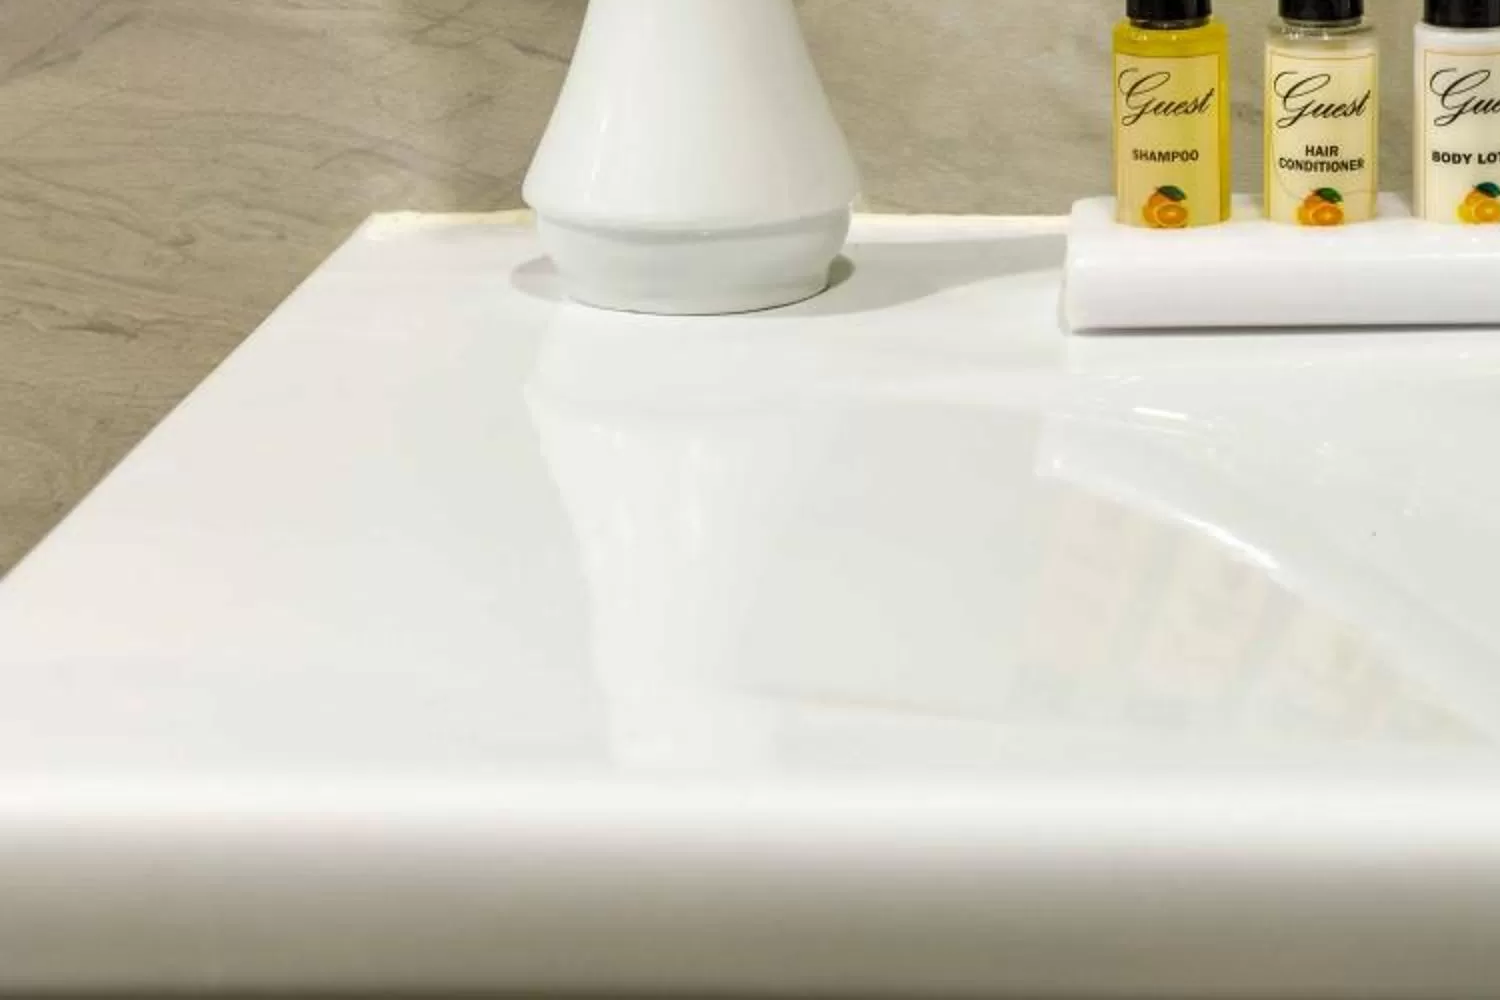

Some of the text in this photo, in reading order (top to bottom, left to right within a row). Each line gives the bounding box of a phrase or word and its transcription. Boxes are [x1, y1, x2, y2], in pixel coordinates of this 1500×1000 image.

[1117, 67, 1215, 127] Guest
[1273, 71, 1371, 128] Guest
[1131, 149, 1199, 162] SHAMPOO
[1304, 145, 1339, 157] HAIR
[1431, 150, 1473, 165] BODY
[1278, 157, 1365, 173] CONDITIONER
